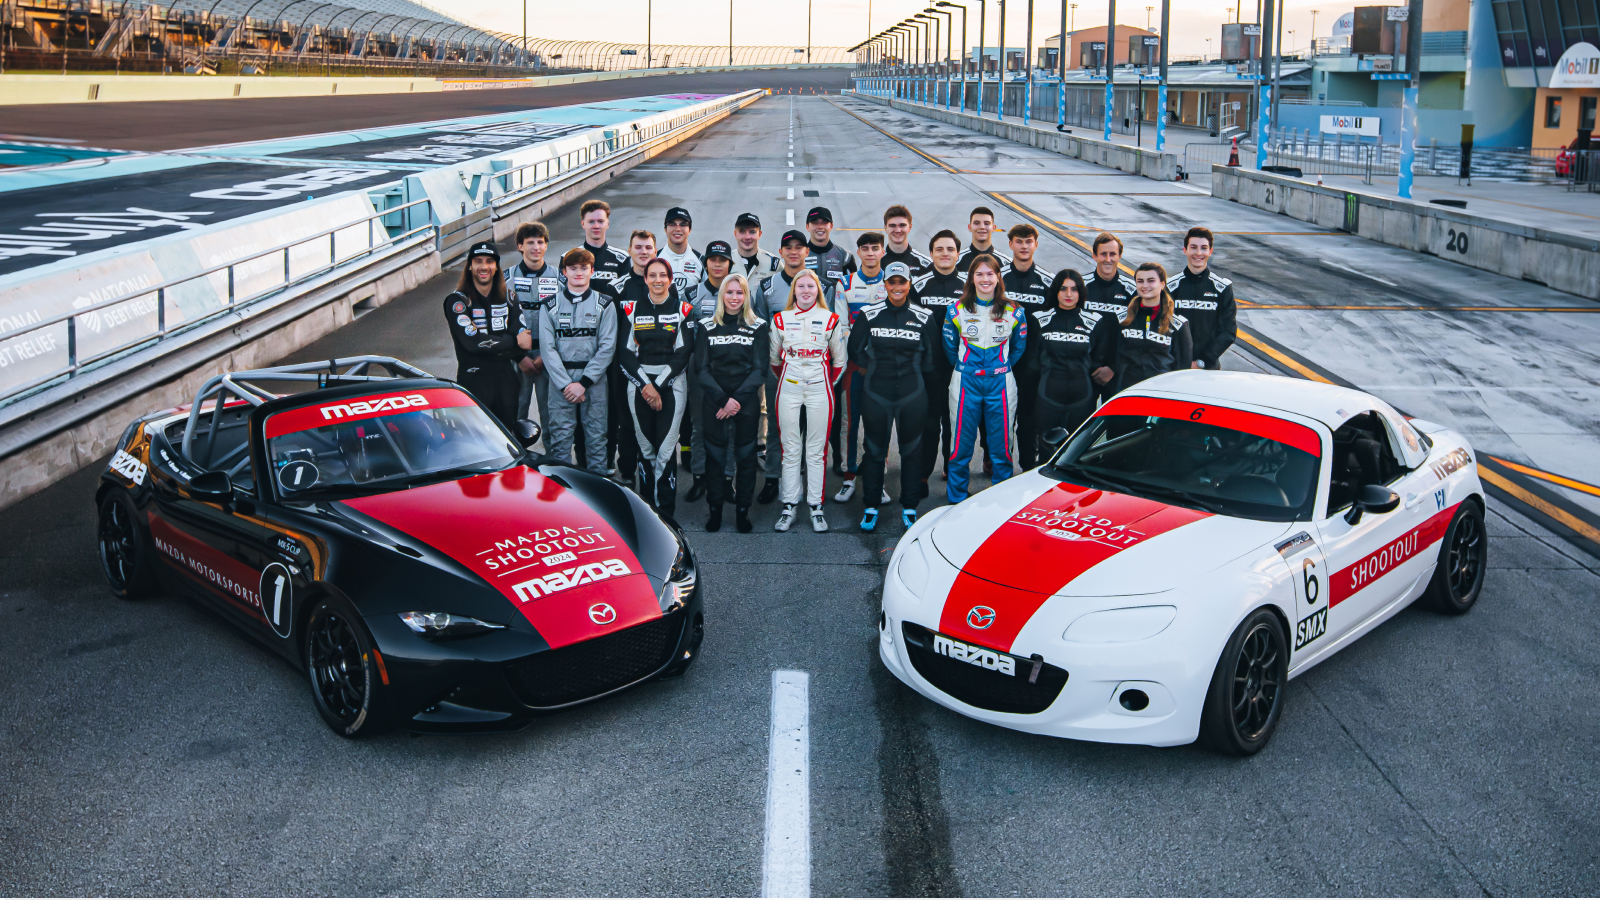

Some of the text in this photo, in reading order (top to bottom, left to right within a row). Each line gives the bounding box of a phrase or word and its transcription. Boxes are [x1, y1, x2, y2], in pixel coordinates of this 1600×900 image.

[1559, 58, 1599, 75] Mobil 1
[1332, 116, 1362, 128] Mobil 1
[1265, 188, 1274, 205] 21
[0, 207, 214, 260] xfinit
[1446, 229, 1469, 255] 20
[103, 306, 133, 328] DEBT
[555, 328, 597, 338] mazda
[708, 334, 755, 346] mazda
[870, 327, 921, 341] mazda
[1041, 331, 1090, 343] mazda
[14, 333, 57, 361] RELIEF
[320, 393, 430, 420] mazda
[1190, 407, 1206, 420] 6
[293, 466, 304, 485] 1
[1428, 447, 1473, 481] mazda
[1016, 511, 1138, 545] SHOOTOUT
[1047, 509, 1127, 532] MAZDA
[494, 526, 577, 551] MAZDA
[1052, 530, 1075, 539] 2024
[484, 532, 607, 570] SHOOTOUT
[547, 553, 573, 565] 2024
[1350, 530, 1419, 590] SHOOTOUT
[155, 536, 260, 607] MAZDA MOTORSPORTS
[511, 558, 632, 602] mazda
[1302, 557, 1319, 605] 6
[273, 574, 286, 626] 1
[1296, 609, 1327, 647] SMX
[934, 634, 1016, 677] mazda
